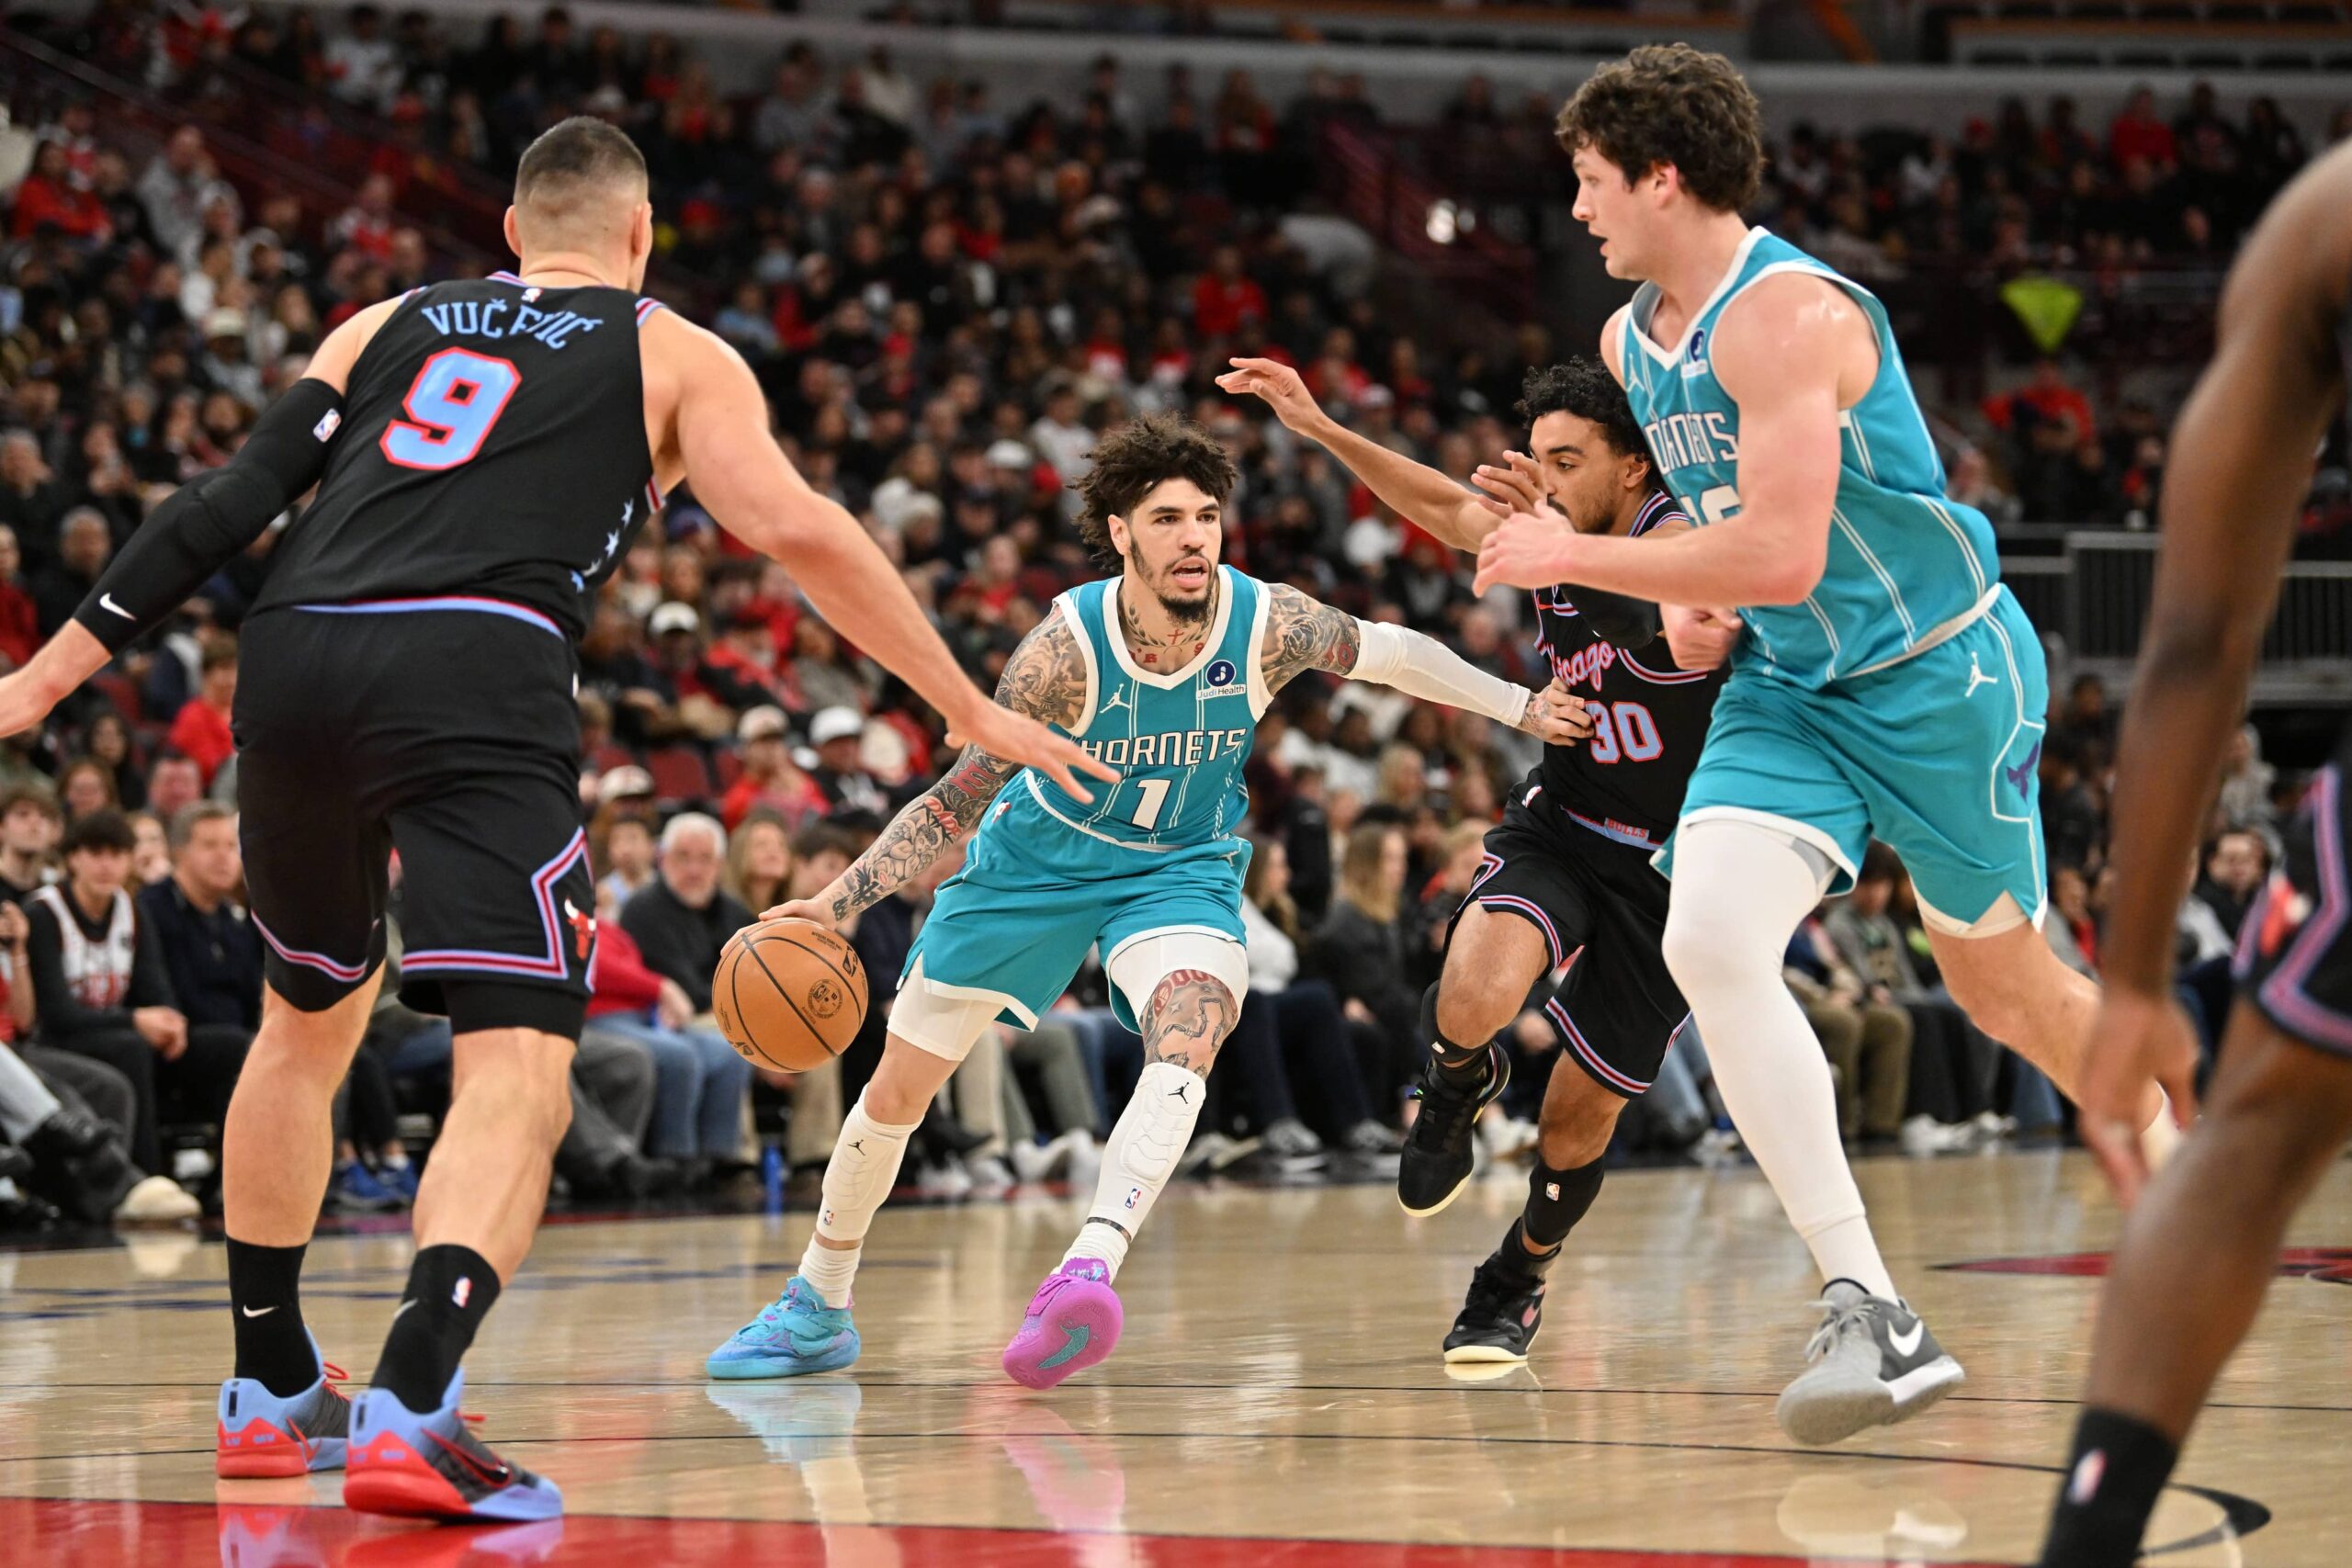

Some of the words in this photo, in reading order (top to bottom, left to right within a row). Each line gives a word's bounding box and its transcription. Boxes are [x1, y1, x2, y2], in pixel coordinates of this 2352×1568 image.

[379, 345, 523, 471] 9
[1198, 689, 1217, 699] Judi
[1217, 684, 1245, 695] Health
[1080, 728, 1248, 767] HORNETS
[1583, 700, 1664, 764] 30
[1130, 778, 1172, 832] 1
[1607, 818, 1647, 839] BULLS
